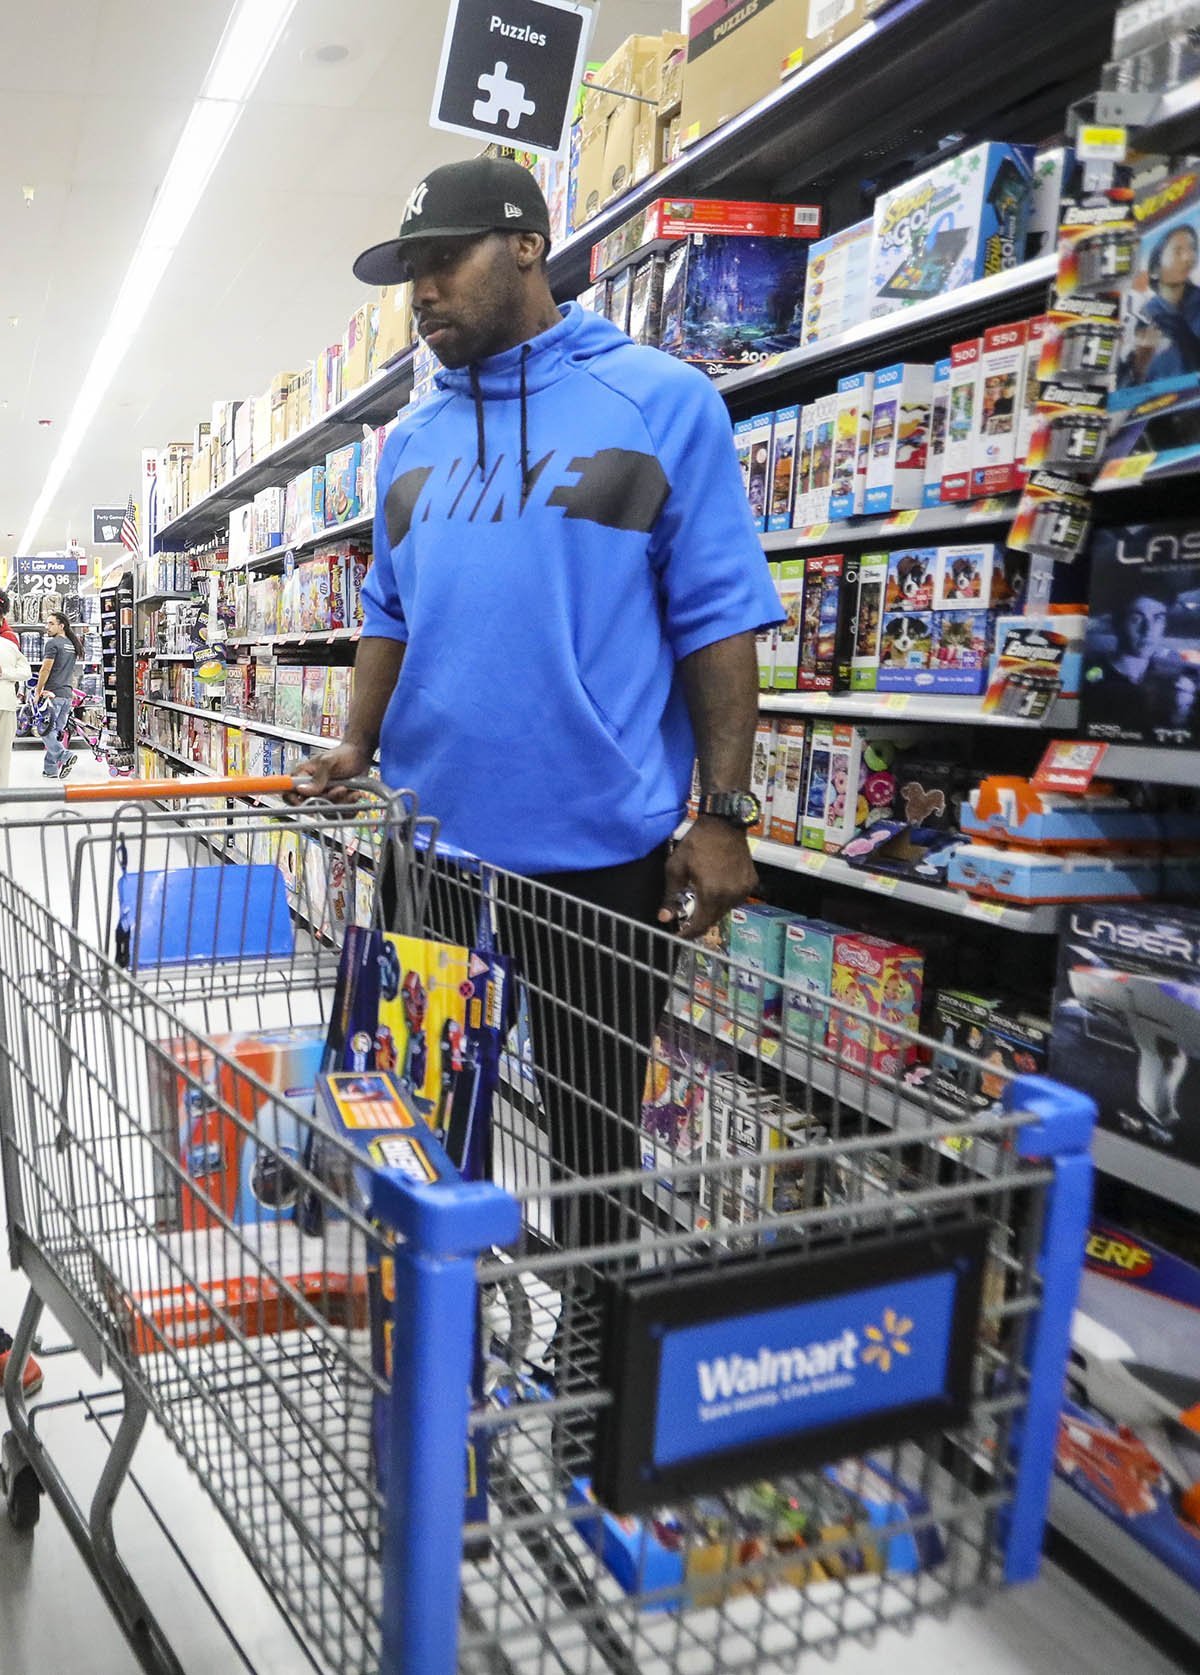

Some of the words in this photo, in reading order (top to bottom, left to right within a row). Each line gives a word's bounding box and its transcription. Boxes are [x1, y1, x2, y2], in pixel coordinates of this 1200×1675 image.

[713, 0, 759, 41] PUZZLES
[489, 15, 547, 47] Puzzles
[991, 331, 1018, 346] 550
[741, 351, 778, 363] 200
[954, 348, 977, 363] 500
[842, 378, 860, 389] 1000
[878, 371, 898, 384] 1000
[754, 417, 769, 428] 1000
[778, 409, 795, 421] 1000
[409, 450, 584, 524] NIKE
[47, 562, 65, 571] Price
[1070, 913, 1193, 962] LASER
[1085, 1234, 1152, 1271] ERF
[697, 1329, 859, 1403] Walmart
